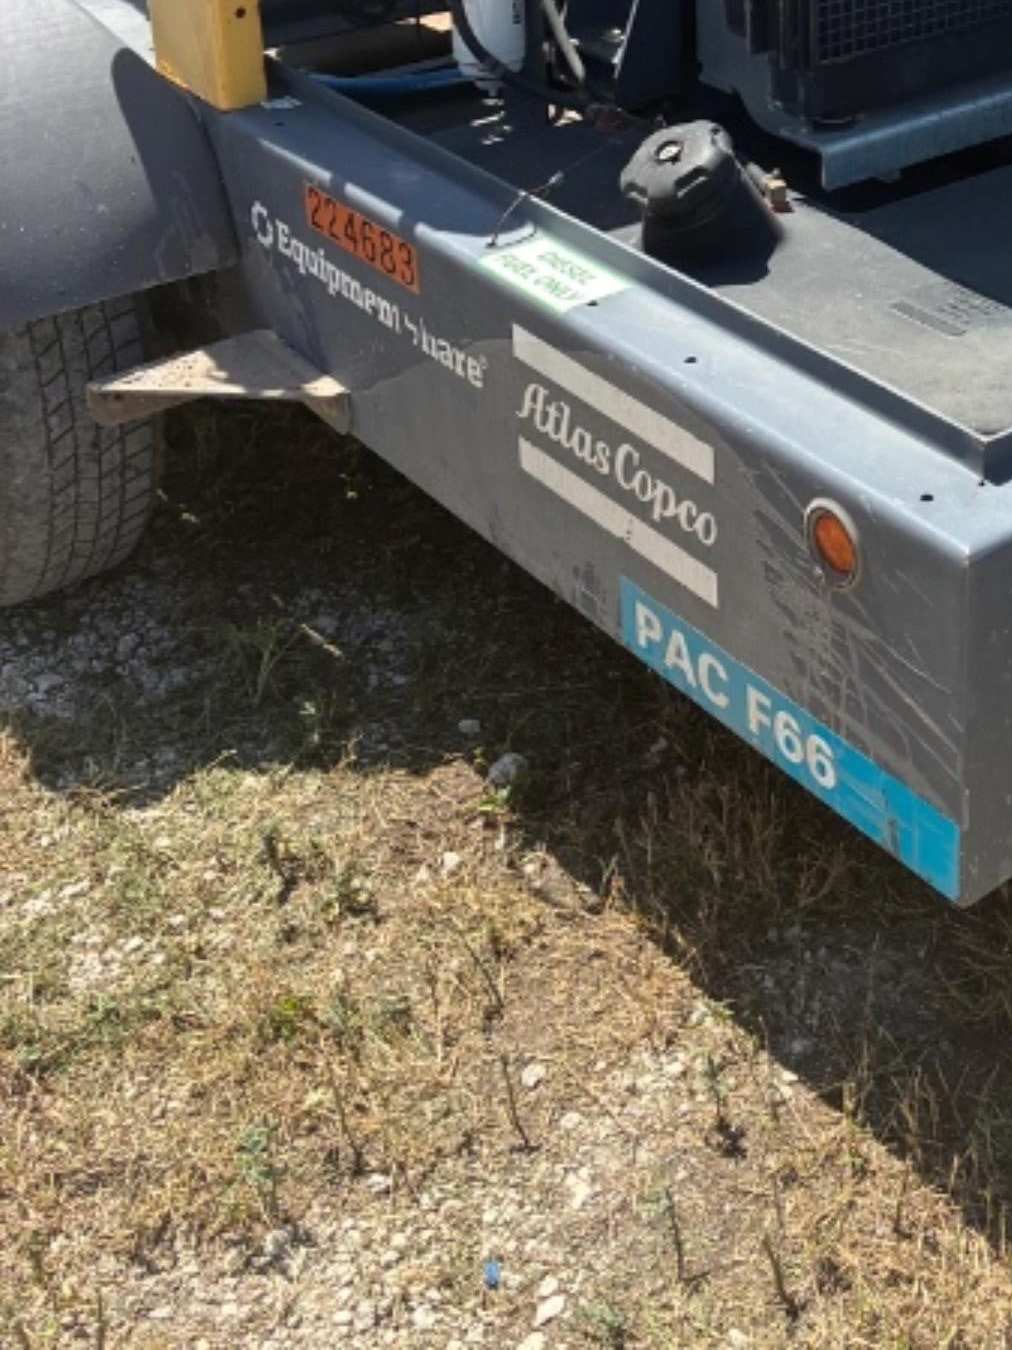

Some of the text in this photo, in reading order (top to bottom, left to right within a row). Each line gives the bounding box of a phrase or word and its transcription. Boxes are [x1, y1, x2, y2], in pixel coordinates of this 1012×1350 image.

[306, 185, 416, 286] 224683
[516, 382, 718, 548] Atlas Copco
[634, 599, 837, 790] PAC F66
